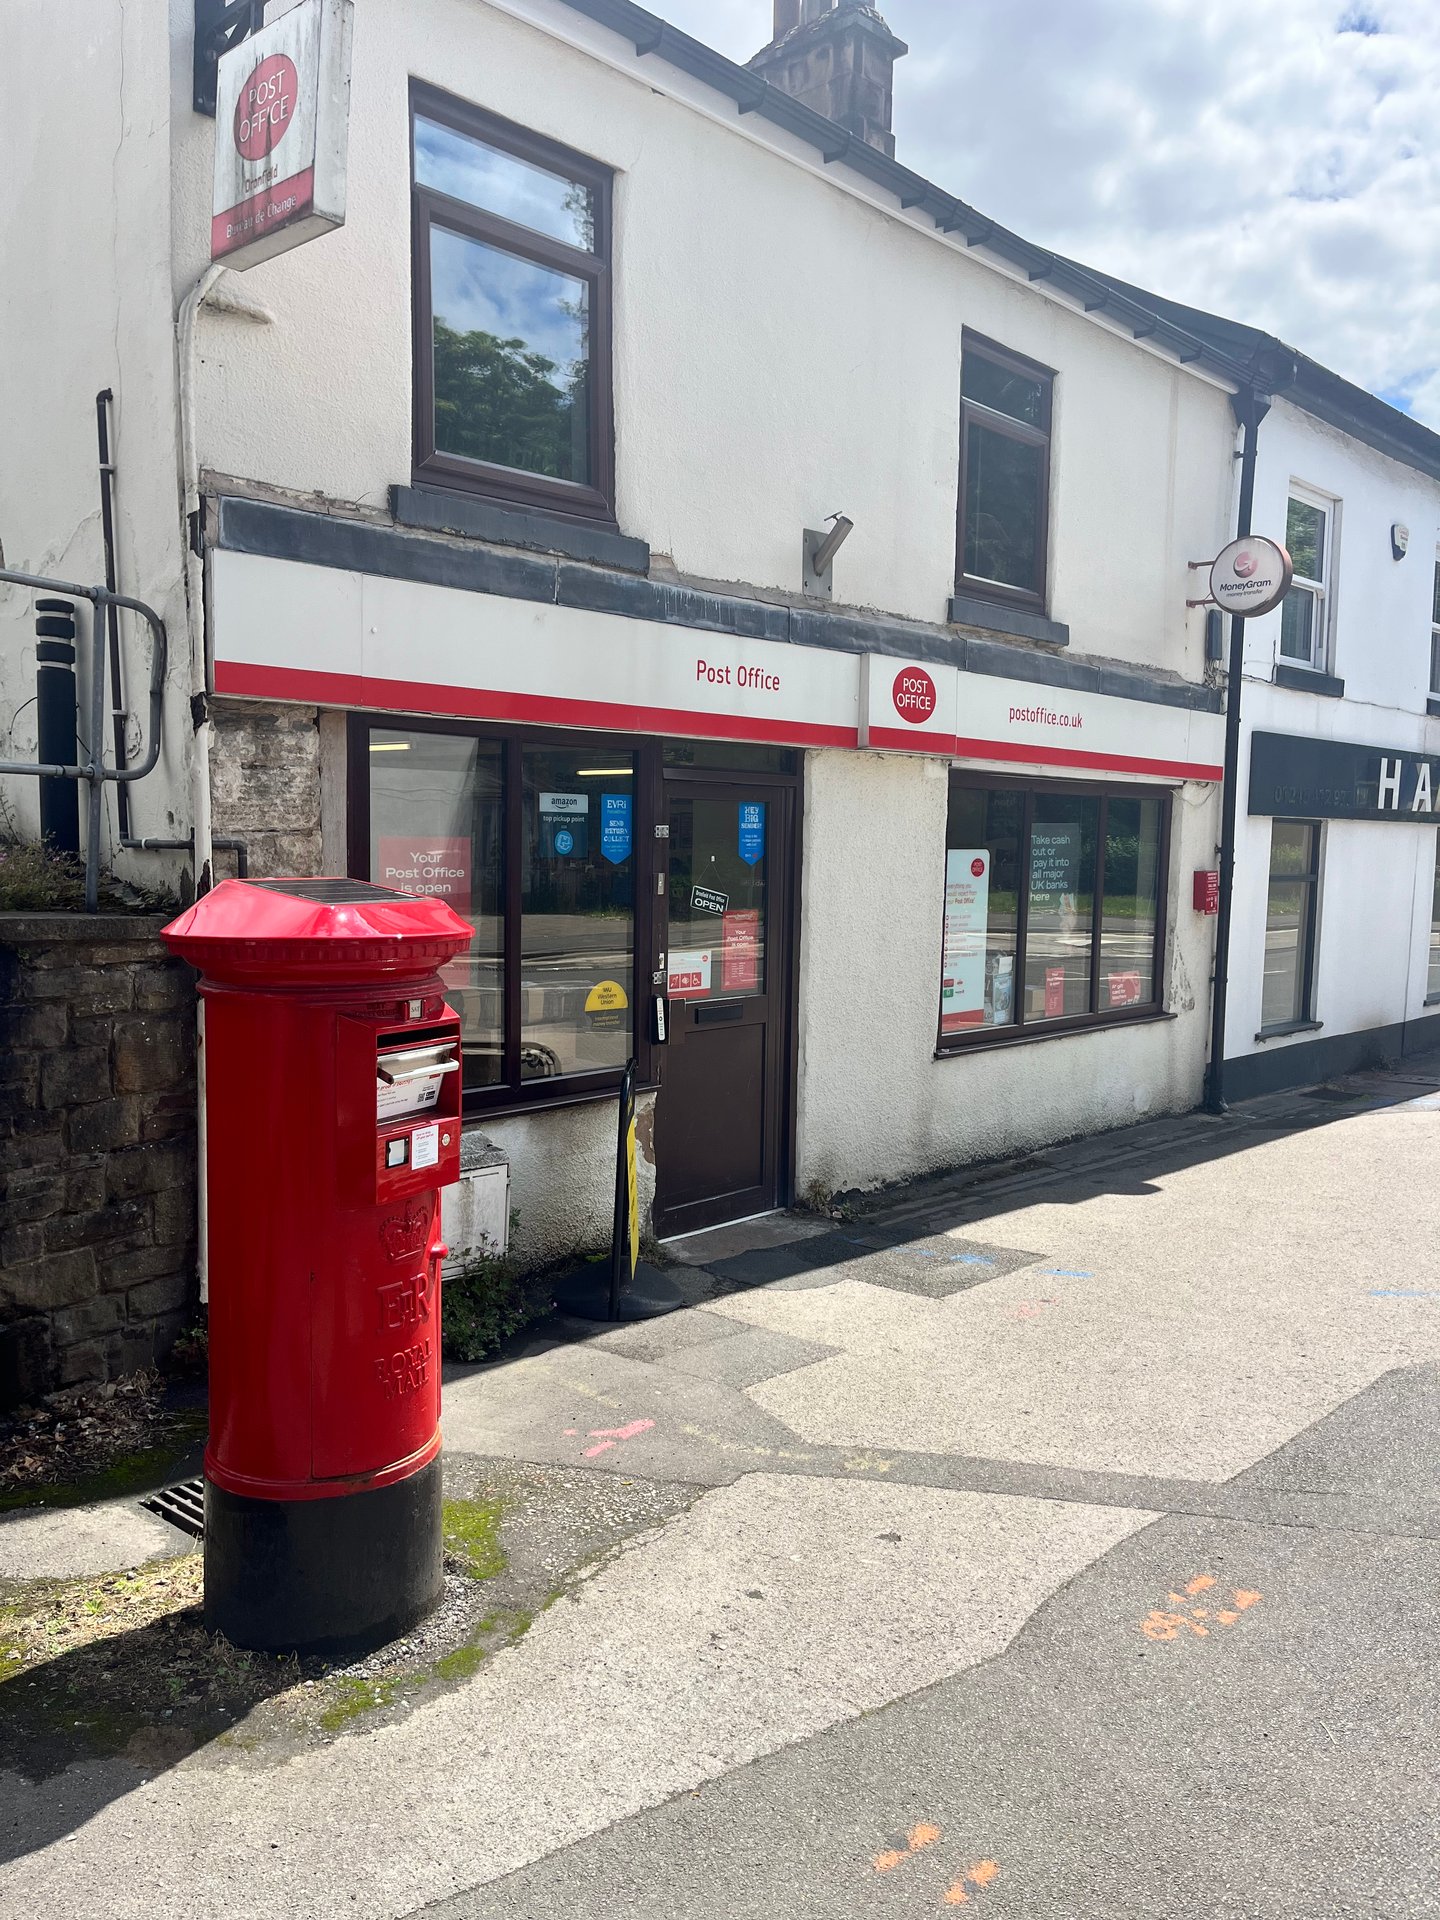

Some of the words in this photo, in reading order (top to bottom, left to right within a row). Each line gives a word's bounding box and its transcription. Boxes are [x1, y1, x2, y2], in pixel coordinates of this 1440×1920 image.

[250, 69, 285, 106] POST
[240, 95, 289, 142] OFFICE
[255, 208, 265, 224] de
[267, 194, 296, 218] Change
[1219, 579, 1271, 592] MoneyGram
[696, 659, 731, 685] Post
[737, 665, 780, 691] Office
[902, 677, 928, 694] POST
[897, 693, 931, 711] OFFICE
[1009, 706, 1082, 728] postoffice.co.uk
[551, 797, 577, 806] amazon
[744, 806, 759, 814] HEY
[543, 815, 552, 823] top
[553, 815, 570, 823] pickup
[571, 816, 585, 824] point
[744, 814, 759, 822] BIG
[1031, 834, 1050, 845] Take
[1051, 834, 1070, 844] cash
[410, 852, 443, 863] Your
[1032, 847, 1046, 856] out
[1047, 848, 1056, 856] or
[1033, 859, 1048, 869] pay
[1048, 857, 1054, 867] it
[1055, 857, 1070, 867] into
[385, 867, 420, 878] Post
[422, 867, 465, 878] Office
[1032, 869, 1041, 879] all
[1042, 868, 1065, 880] major
[401, 882, 413, 892] is
[415, 884, 452, 895] open
[1031, 880, 1045, 890] UK
[1045, 880, 1068, 890] banks
[1029, 892, 1050, 902] here
[694, 897, 724, 912] OPEN
[410, 1005, 420, 1013] SAT
[373, 1337, 432, 1384] ROYAL
[382, 1361, 430, 1401] MAIL
